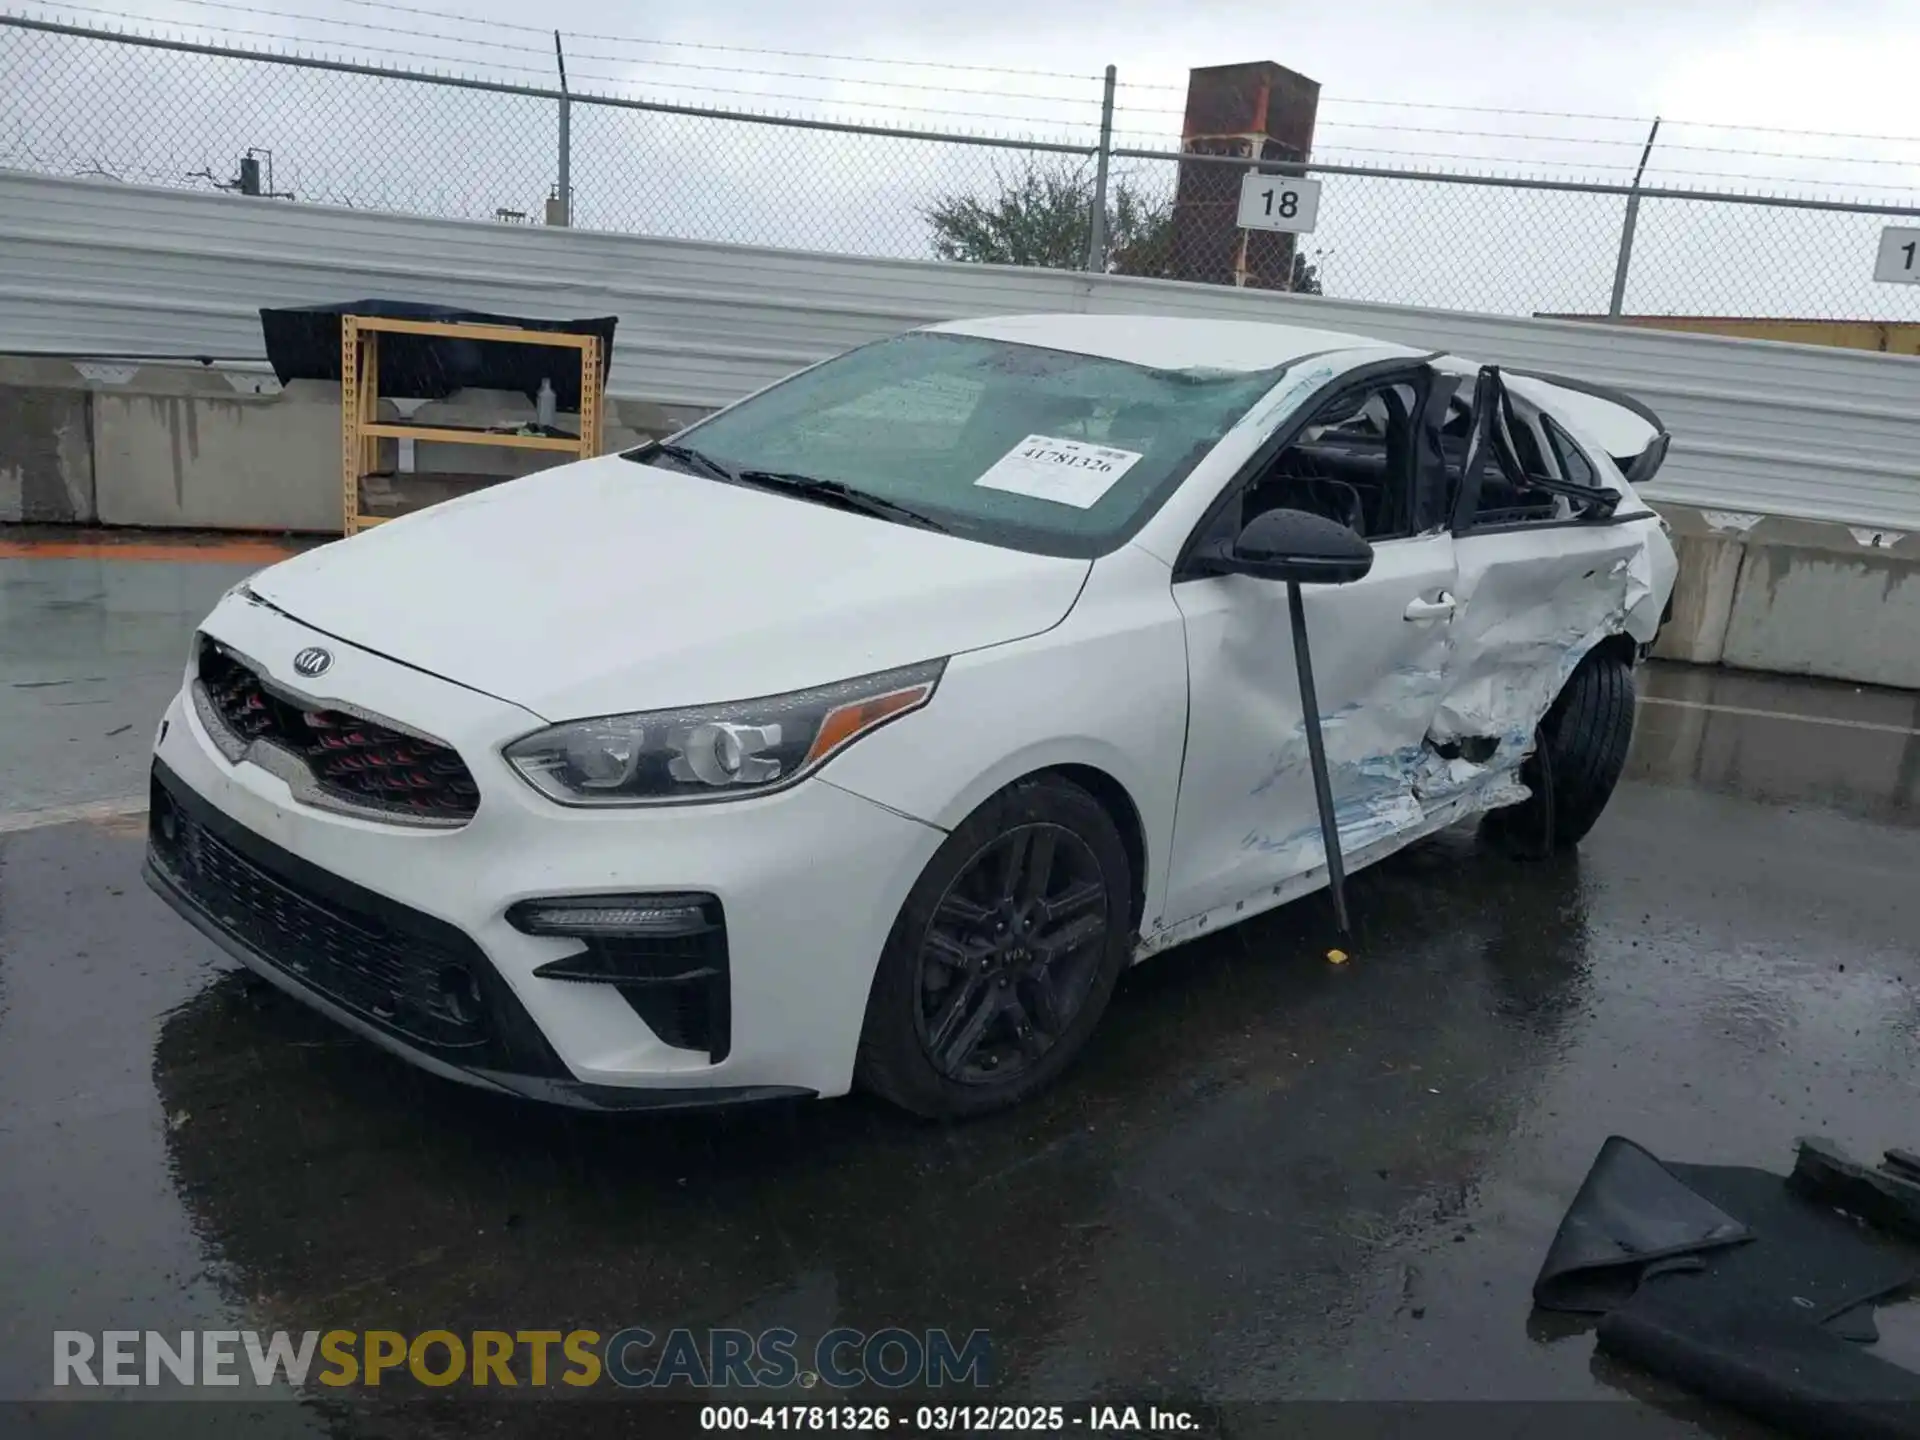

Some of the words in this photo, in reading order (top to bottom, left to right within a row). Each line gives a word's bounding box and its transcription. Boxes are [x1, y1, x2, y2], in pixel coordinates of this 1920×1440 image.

[1261, 188, 1299, 219] 18
[1023, 447, 1113, 472] 41781326
[297, 651, 325, 672] KIA
